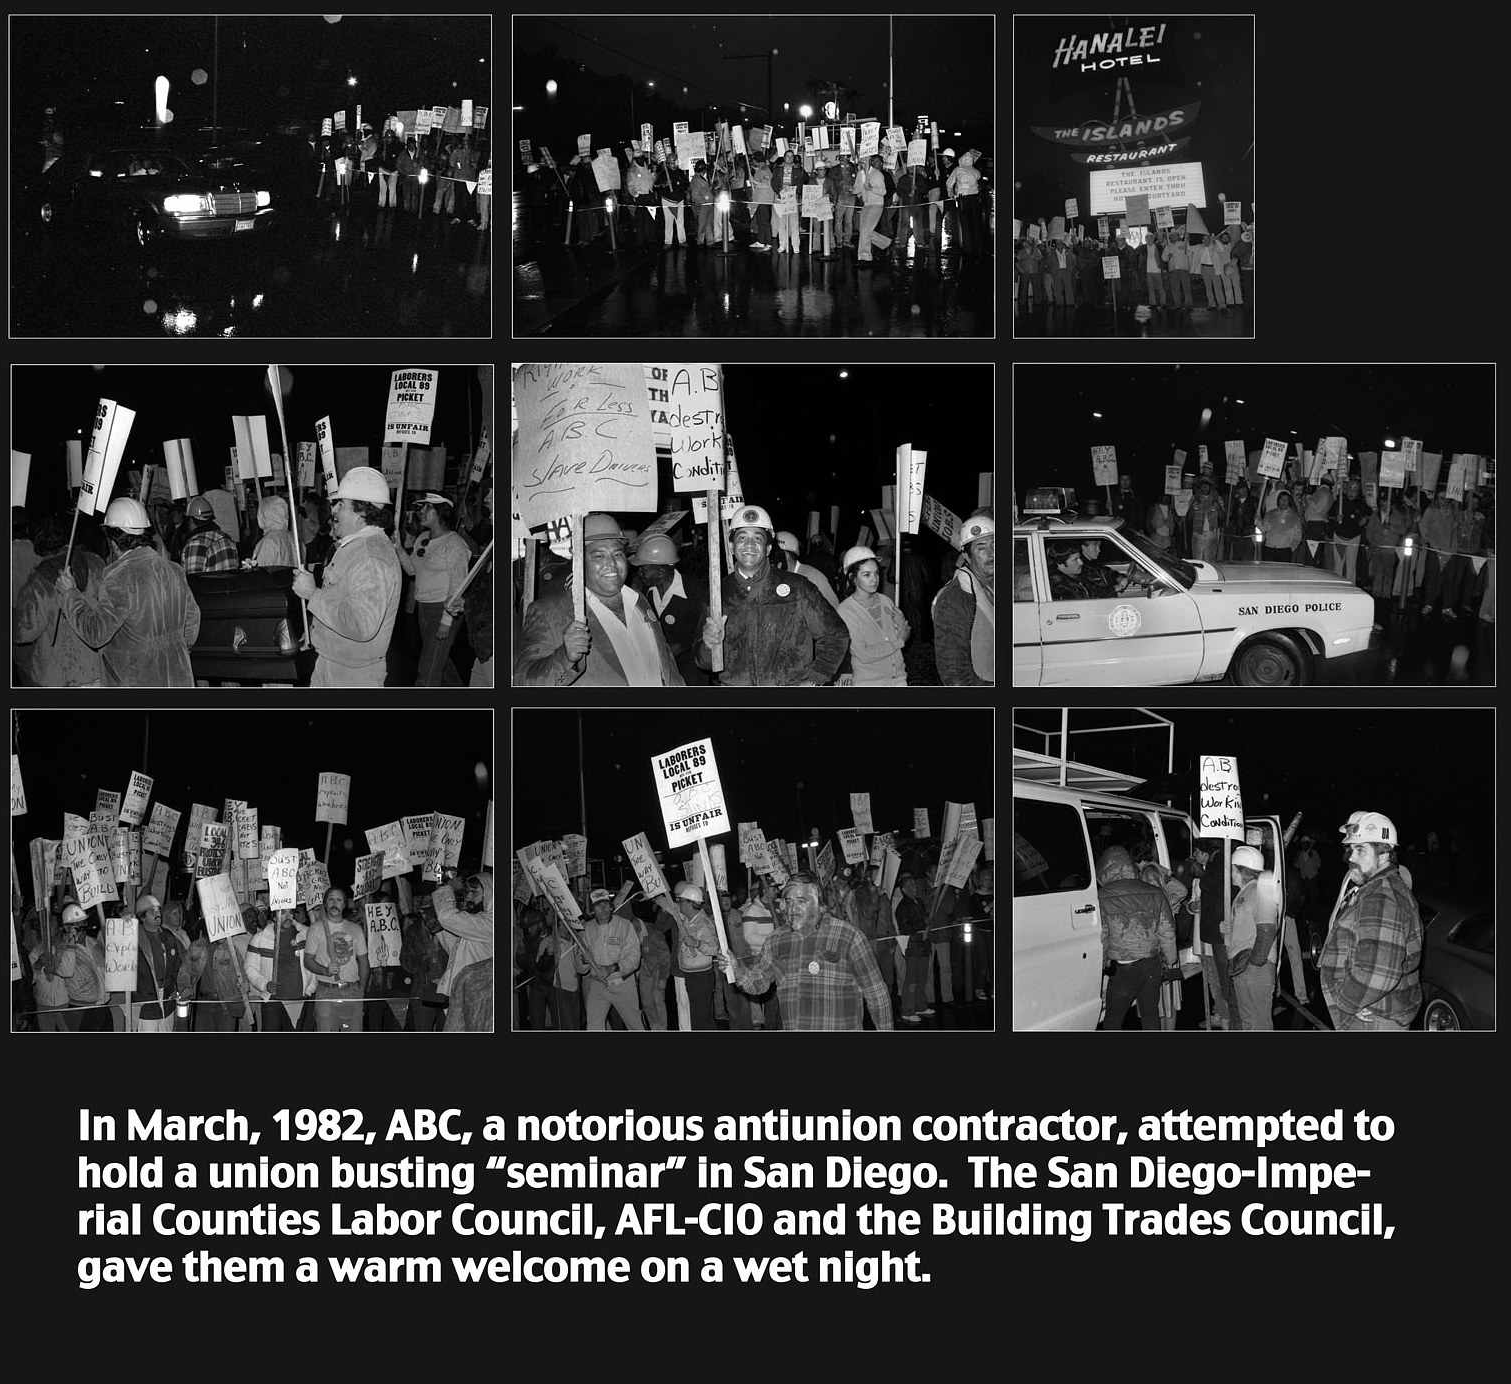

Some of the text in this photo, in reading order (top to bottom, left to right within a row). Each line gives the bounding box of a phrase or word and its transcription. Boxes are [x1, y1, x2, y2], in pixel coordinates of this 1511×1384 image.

[1052, 23, 1167, 69] HANALEI
[1081, 53, 1161, 72] HOTEL
[1054, 110, 1185, 142] THE ISLANDS
[1086, 143, 1178, 164] RESTAURANT
[1139, 168, 1171, 177] ISLANDS
[1105, 177, 1154, 187] RESTAURANT
[1110, 186, 1138, 194] PLEASE
[1139, 184, 1163, 192] ENTER
[394, 372, 432, 382] LABORERS
[547, 365, 601, 392] WORK
[395, 381, 430, 390] LOCAL 89
[397, 393, 424, 402] PICKET
[597, 393, 633, 413] Less
[396, 423, 429, 432] UNFAIR
[1239, 603, 1341, 615] SAN DIEGO POLICE
[658, 744, 707, 770] LABORERS
[662, 755, 707, 780] LOCAL 89
[321, 775, 346, 785] ABC
[671, 771, 704, 793] PICKET
[90, 814, 117, 823] BUST
[669, 808, 723, 832] IS UNFAIR
[205, 825, 227, 837] LOCAL
[408, 822, 424, 830] LOCAL
[412, 829, 430, 837] PICKET
[66, 834, 108, 856] UNION
[71, 857, 86, 871] THE
[97, 866, 109, 876] TO
[272, 867, 296, 878] ABC
[638, 864, 653, 879] WAY
[78, 882, 115, 904] BUILD
[367, 906, 393, 918] HEY
[207, 912, 242, 936] UNION
